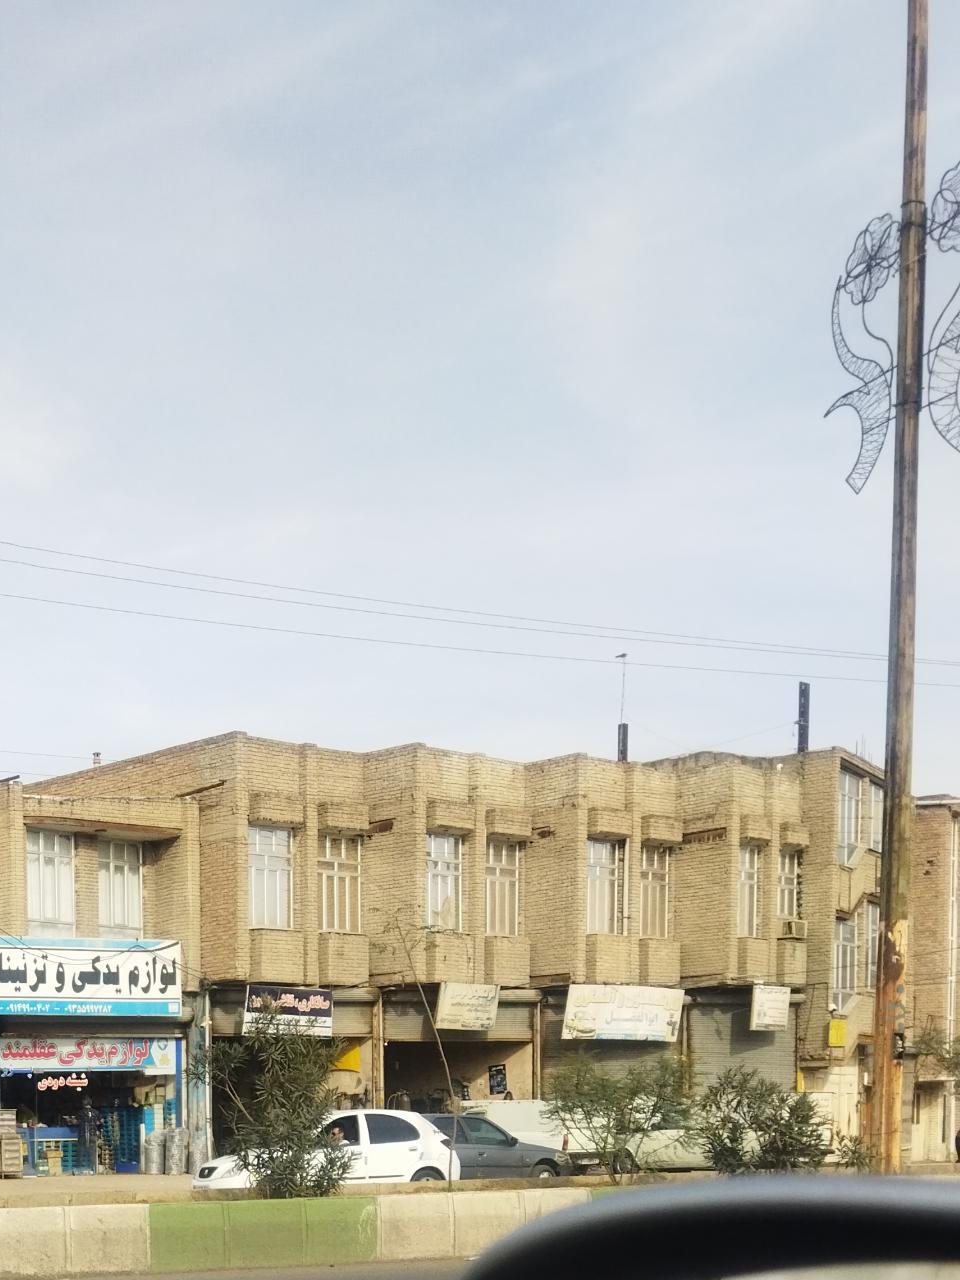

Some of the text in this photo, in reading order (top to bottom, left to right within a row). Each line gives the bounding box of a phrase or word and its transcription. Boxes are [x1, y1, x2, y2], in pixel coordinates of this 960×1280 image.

[55, 961, 65, 993] و
[71, 954, 121, 994] یدکی
[128, 956, 177, 995] لوازم
[0, 1038, 150, 1066] لوازم یدکی عقلمند
[37, 1072, 89, 1092] شیشه دودی
